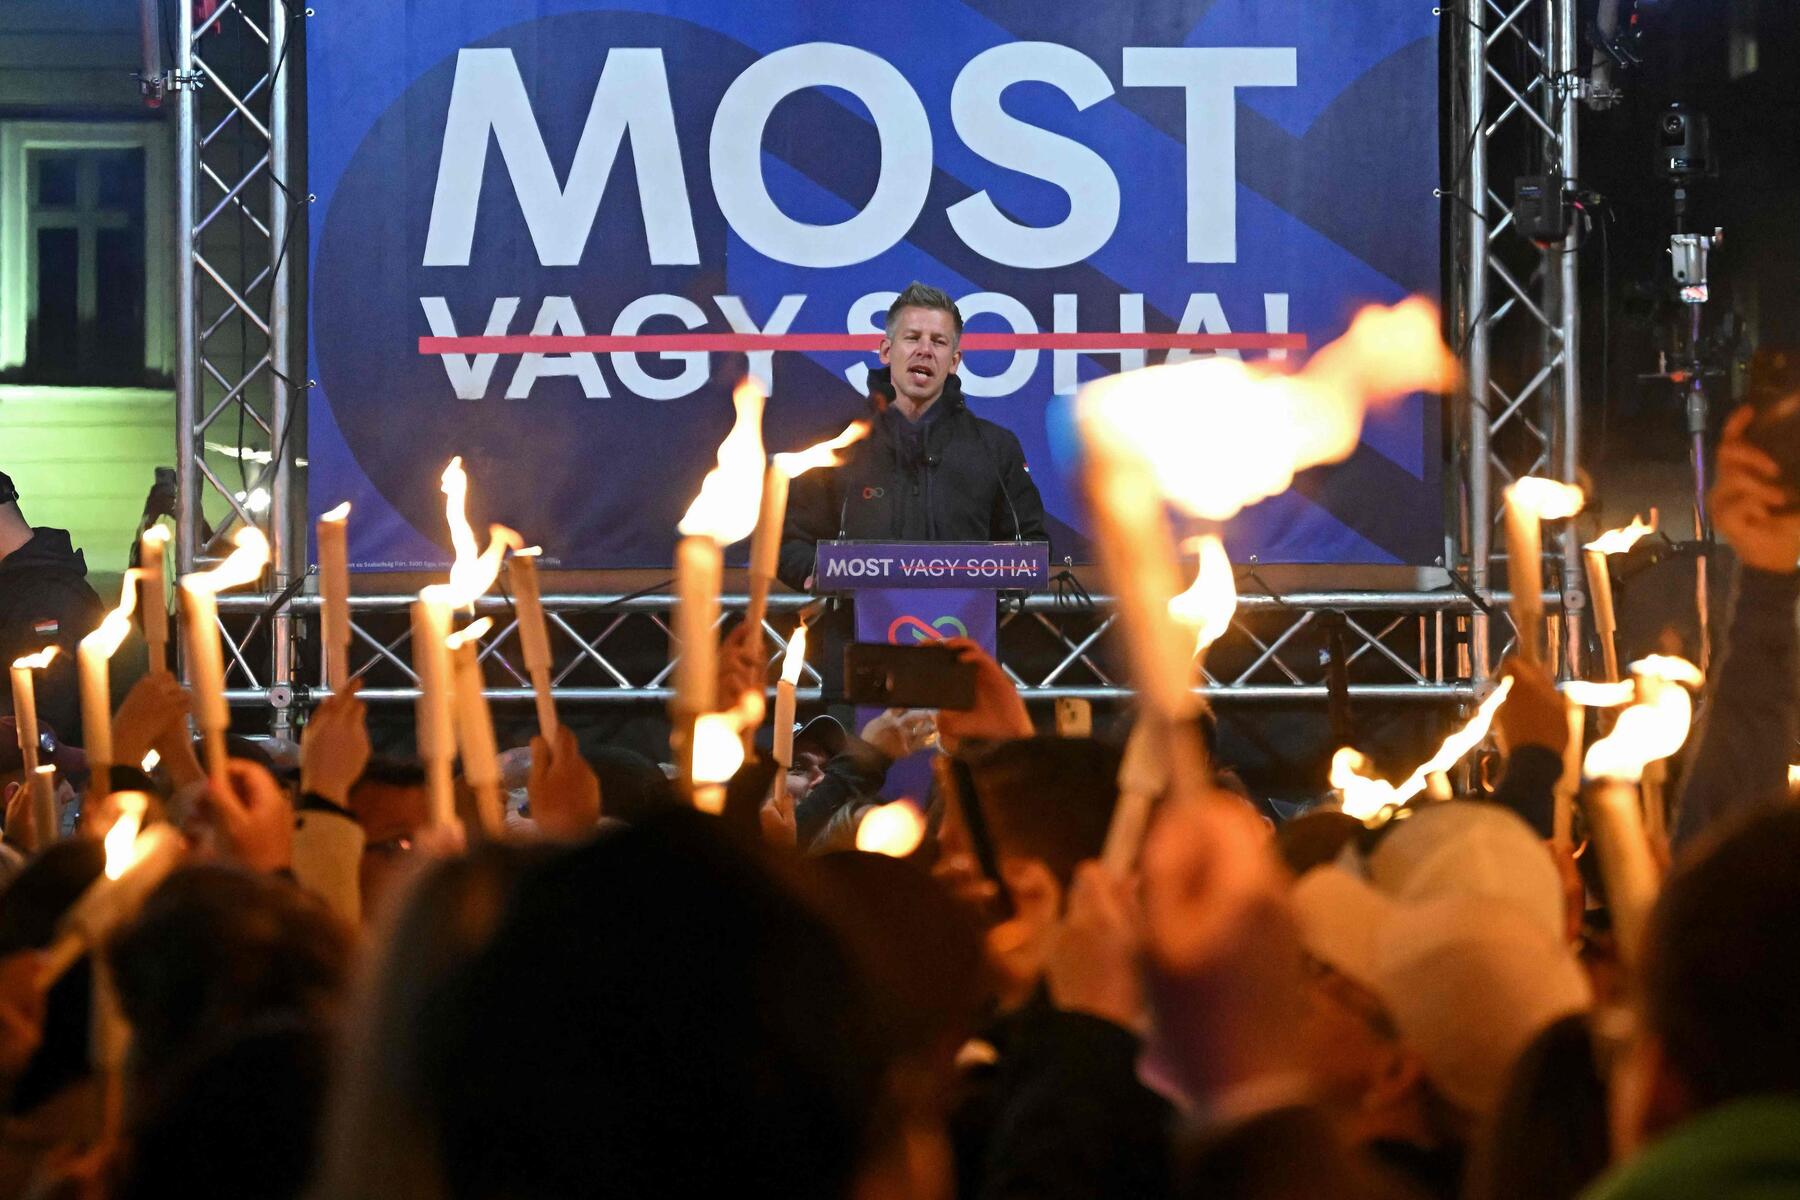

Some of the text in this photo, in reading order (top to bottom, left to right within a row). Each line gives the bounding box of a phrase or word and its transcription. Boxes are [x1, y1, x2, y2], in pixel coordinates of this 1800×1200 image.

[422, 41, 1298, 269] MOST
[419, 293, 808, 401] VAGY
[826, 558, 1038, 577] MOST VAGY SOHA!
